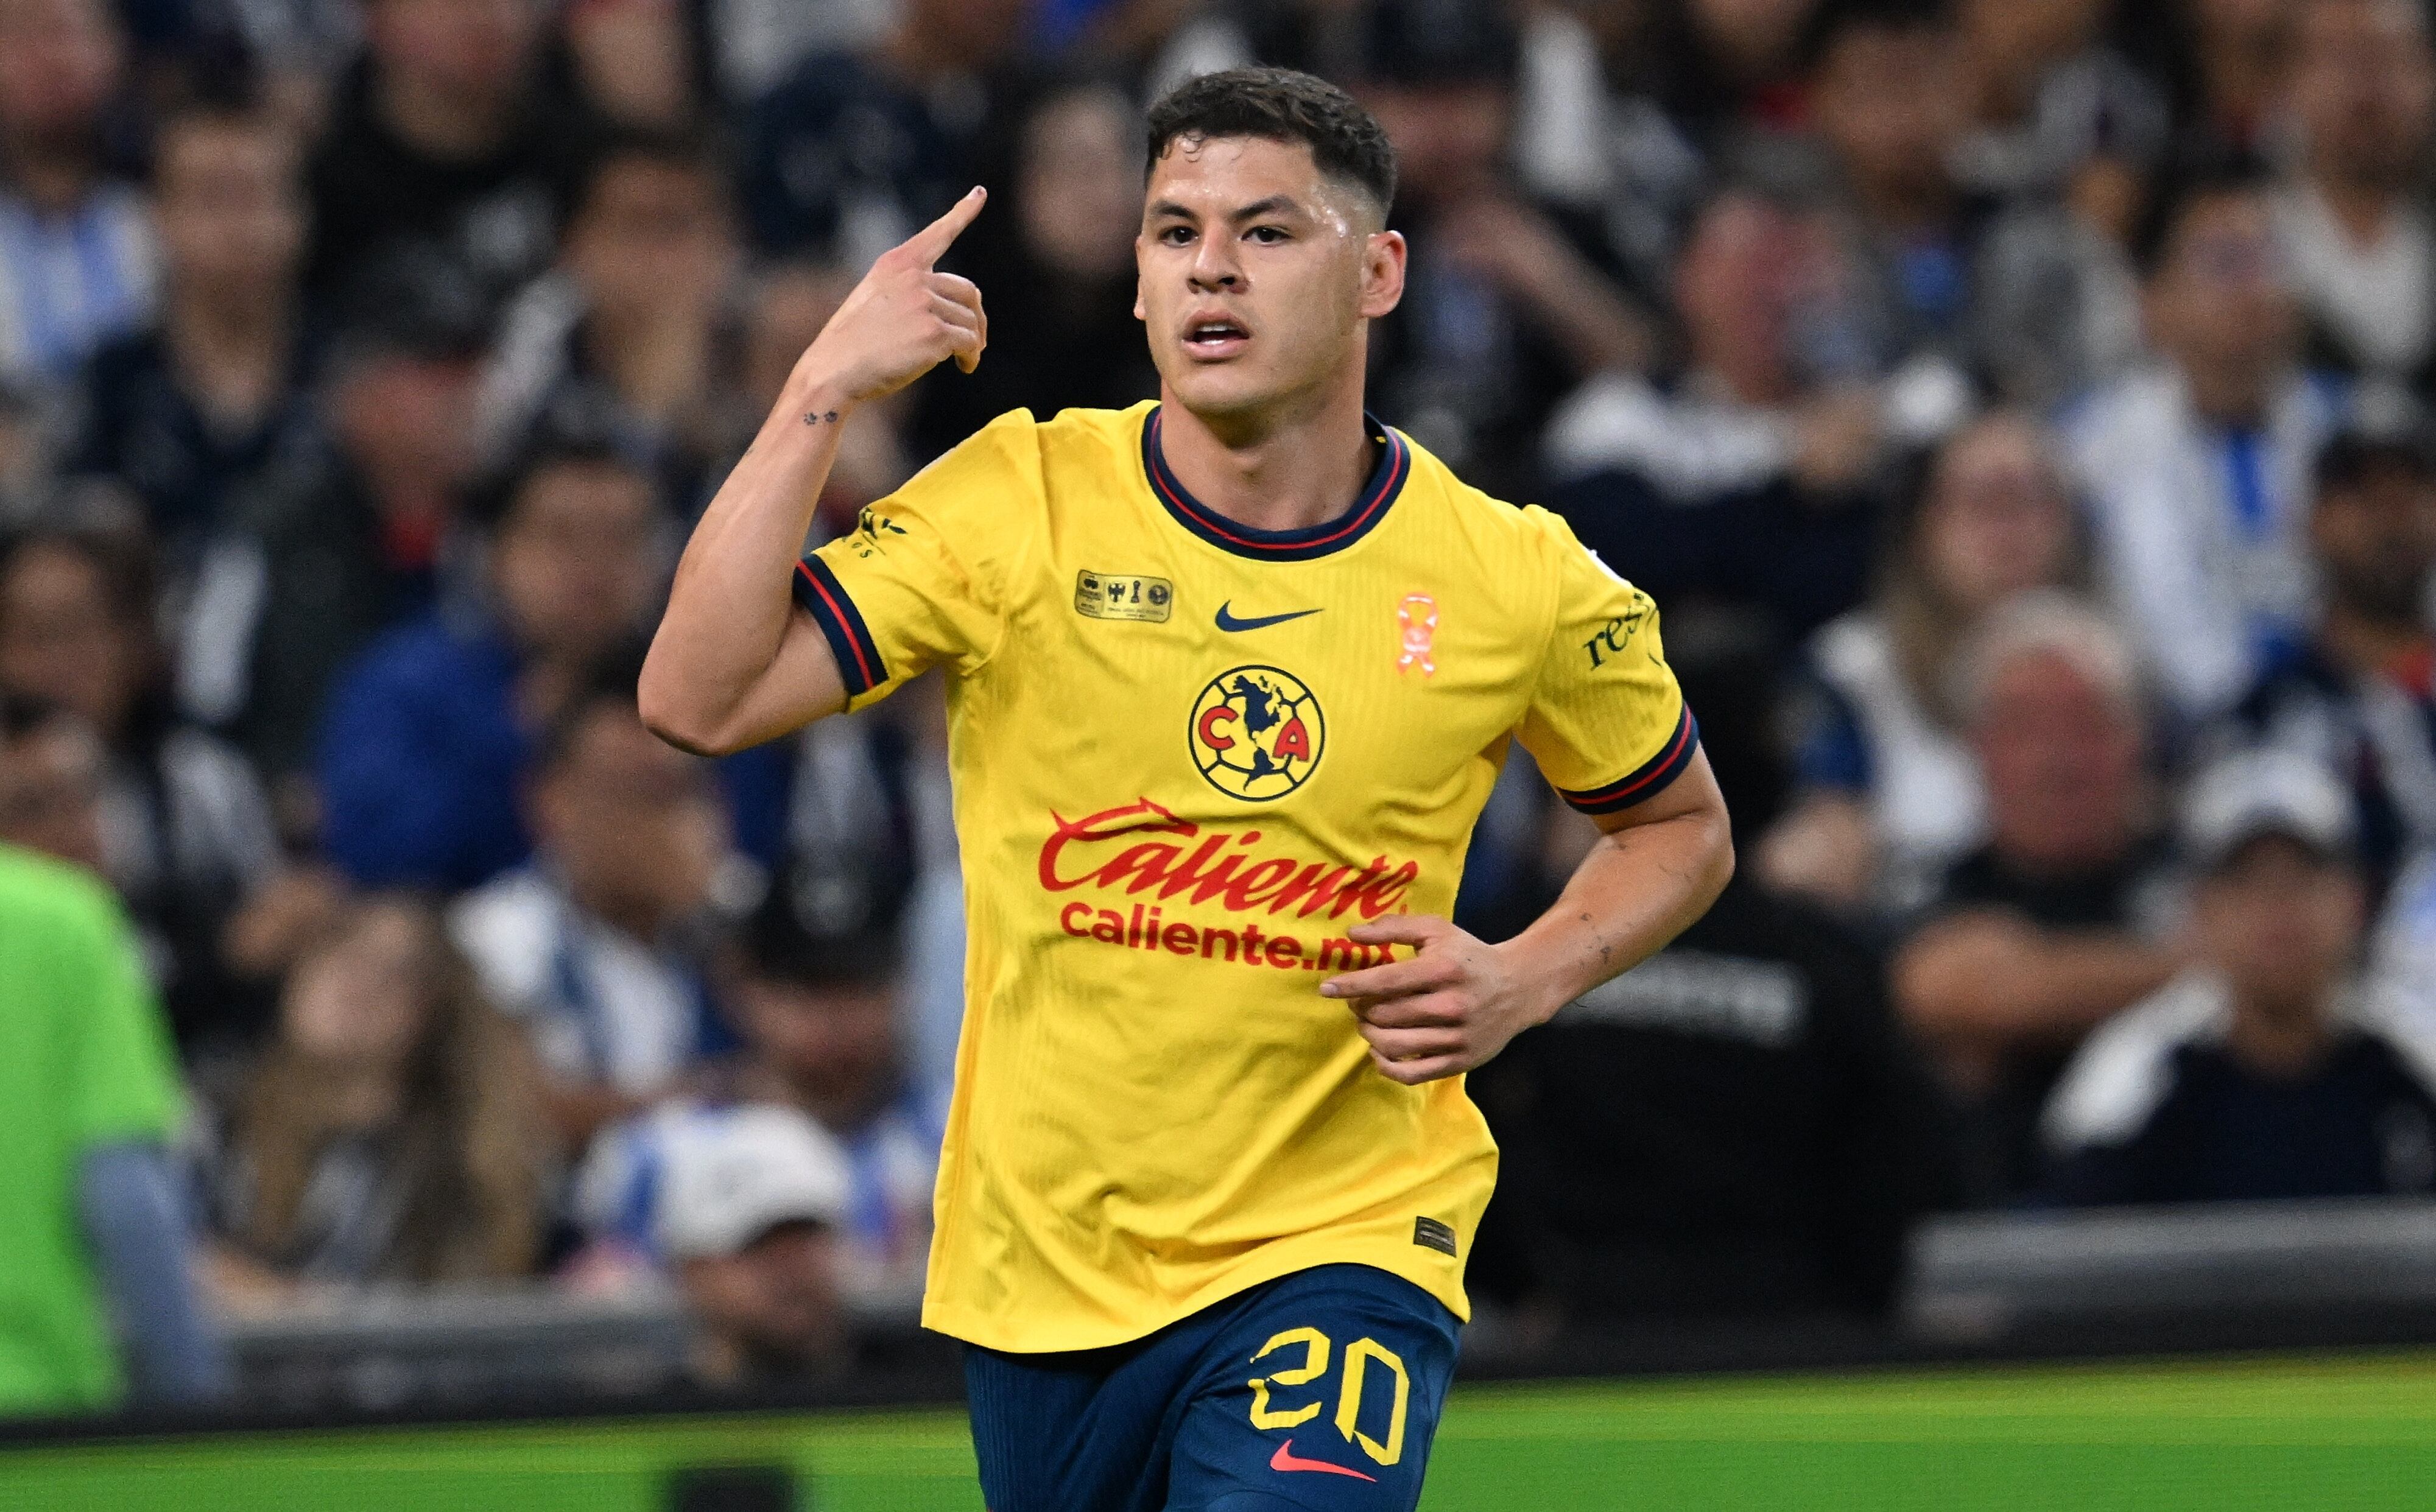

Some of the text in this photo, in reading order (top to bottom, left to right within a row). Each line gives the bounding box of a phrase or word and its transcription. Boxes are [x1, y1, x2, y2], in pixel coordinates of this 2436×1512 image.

[1198, 705, 1309, 762] C A
[1038, 795, 1418, 920] Caliente
[1248, 1326, 1410, 1466] 20
